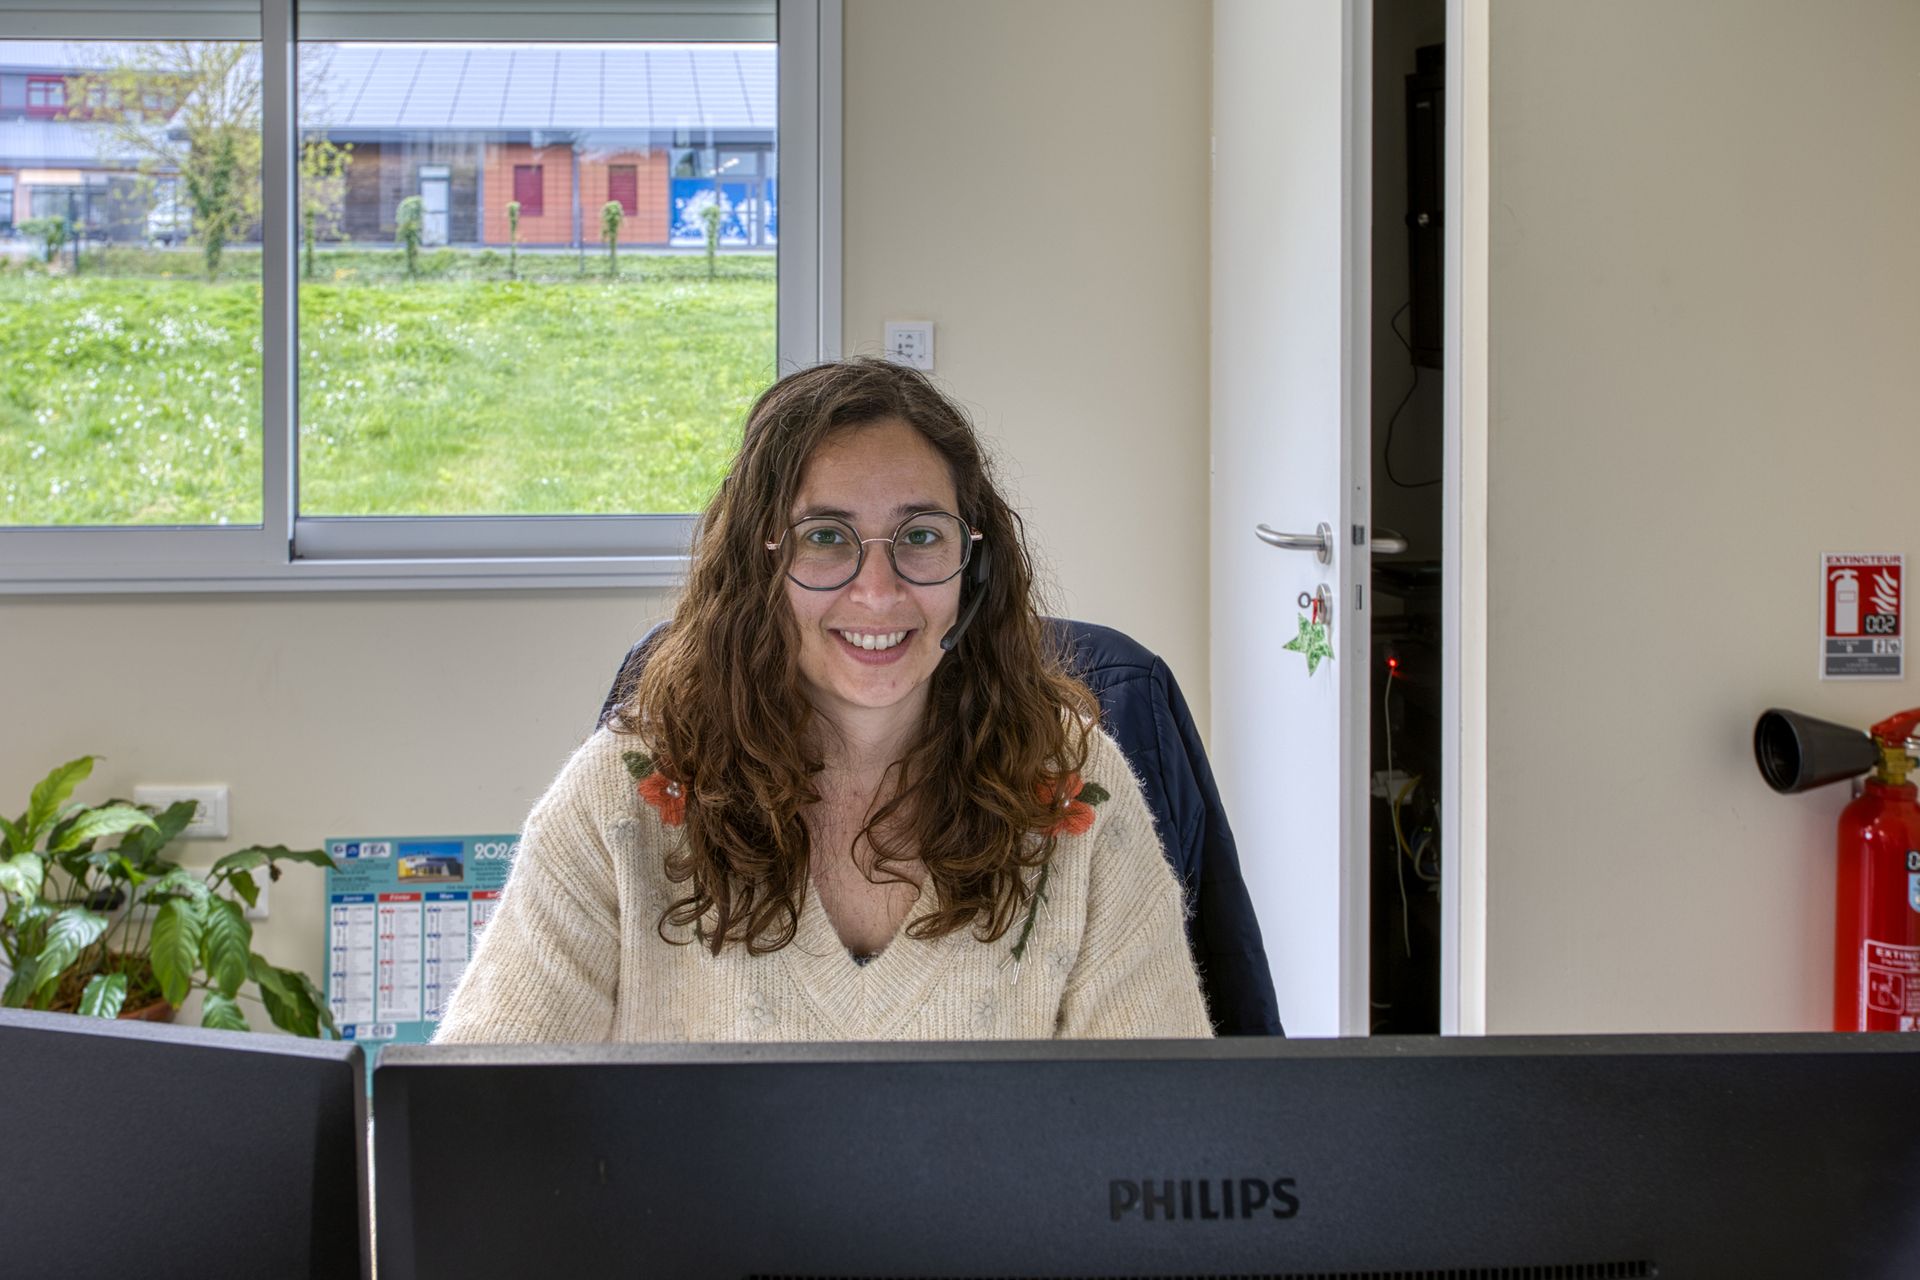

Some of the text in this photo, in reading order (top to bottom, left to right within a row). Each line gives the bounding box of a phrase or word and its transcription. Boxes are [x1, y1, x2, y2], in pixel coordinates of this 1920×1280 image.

[1826, 555, 1901, 564] EXTINCTEUR
[1866, 615, 1895, 634] 002
[1109, 1178, 1300, 1221] PHILIPS
